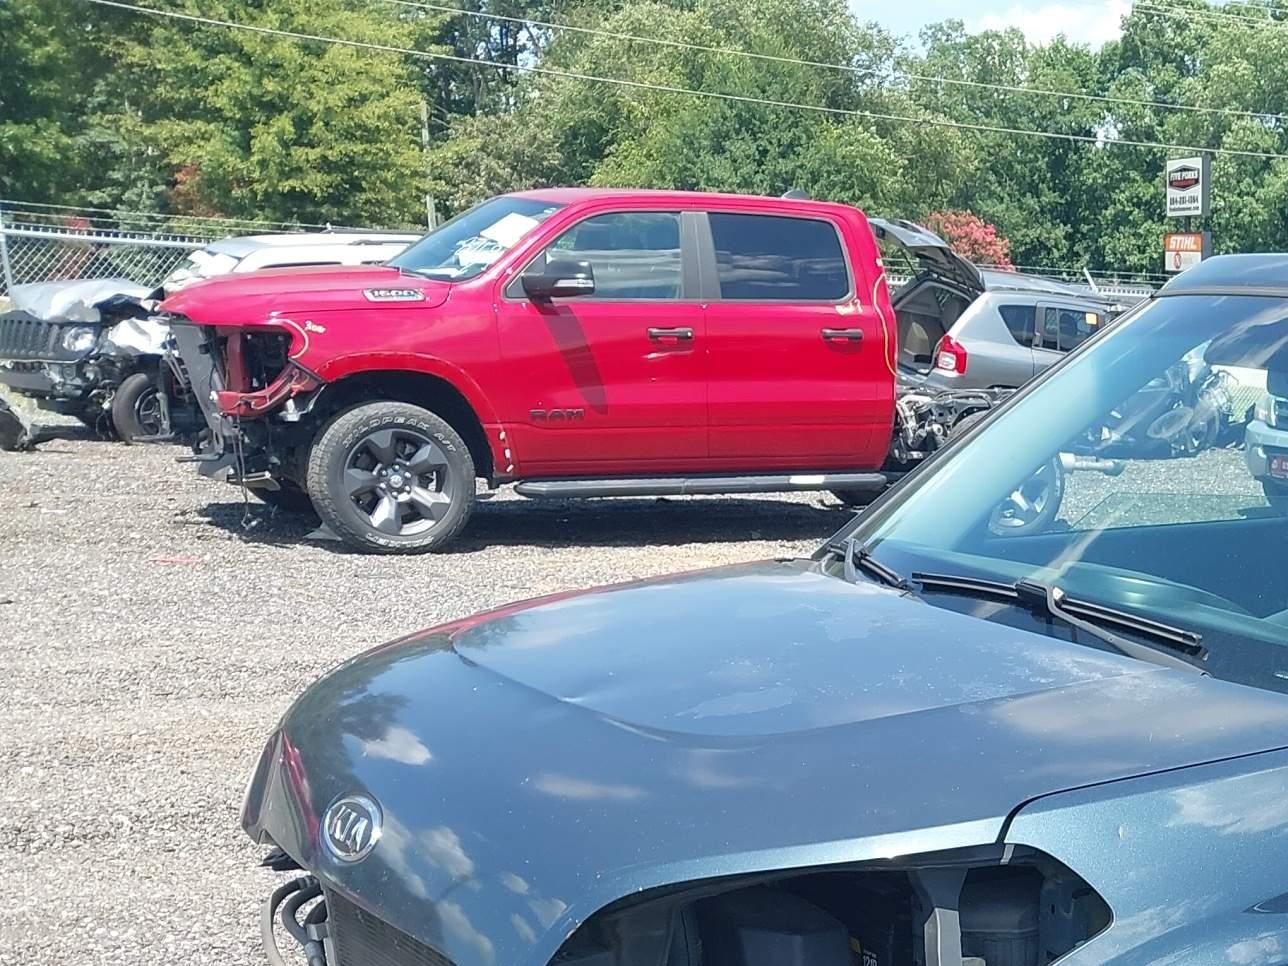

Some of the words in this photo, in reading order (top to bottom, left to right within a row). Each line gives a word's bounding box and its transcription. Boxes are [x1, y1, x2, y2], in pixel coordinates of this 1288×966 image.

[1170, 235, 1197, 249] STIHL
[529, 408, 585, 421] RAM
[329, 805, 369, 853] KIA
